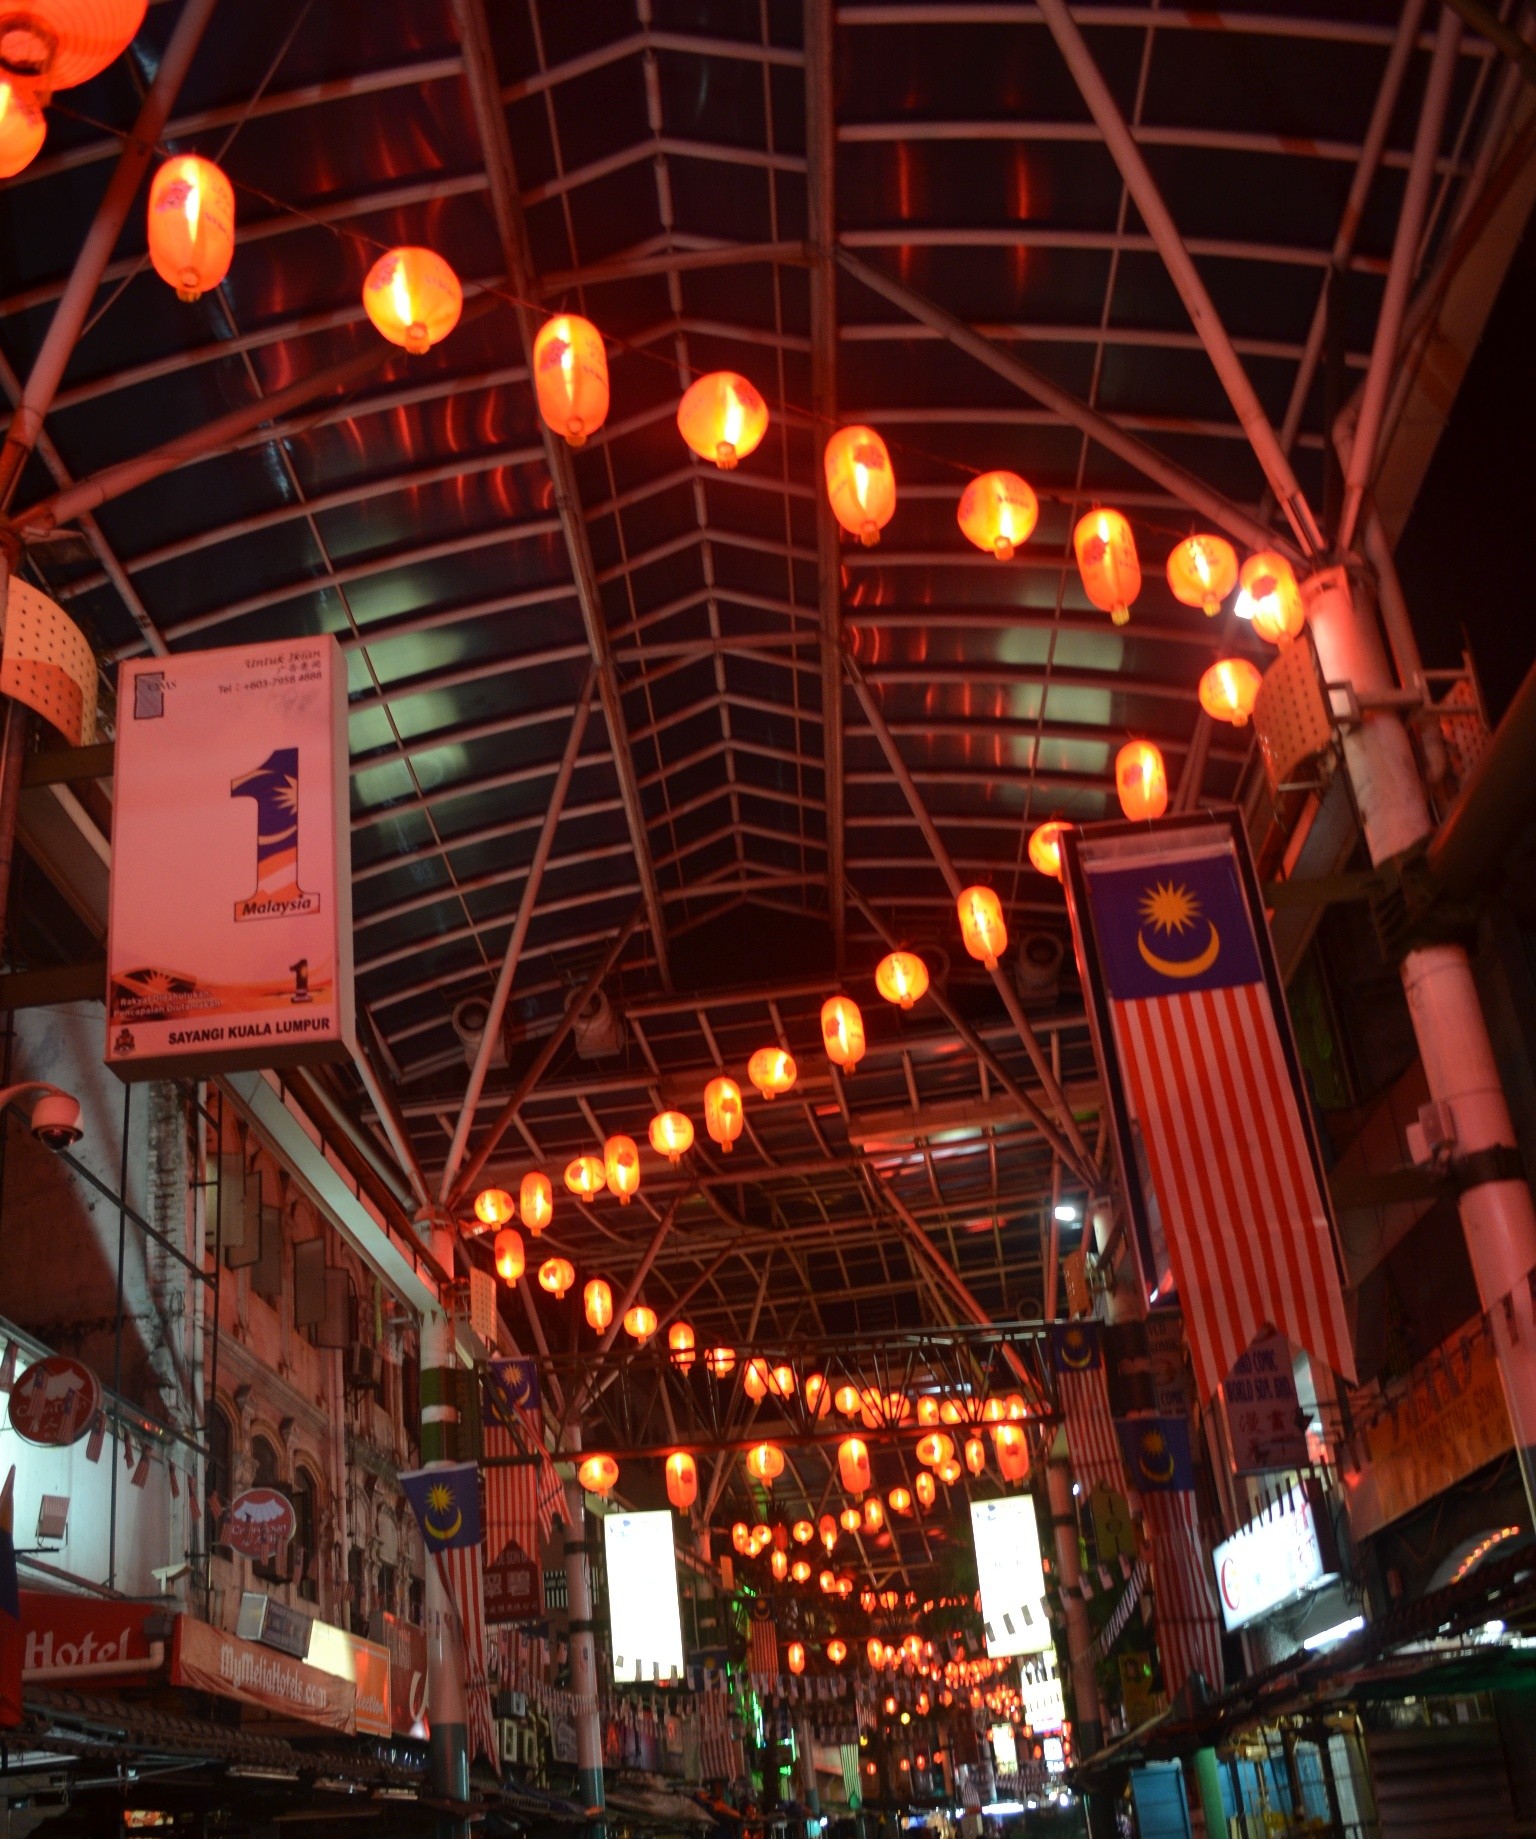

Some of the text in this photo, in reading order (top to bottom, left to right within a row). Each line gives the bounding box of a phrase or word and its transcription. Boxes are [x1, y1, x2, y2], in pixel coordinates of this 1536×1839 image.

[246, 656, 283, 668] Untuk
[219, 684, 232, 694] Tel
[231, 747, 321, 922] 1
[242, 894, 311, 916] Malaysia
[168, 1017, 330, 1045] SAYANGI KUALA LUMPUR
[24, 1626, 131, 1669] Hotel
[221, 1643, 327, 1708] MyMeliaHotels.com
